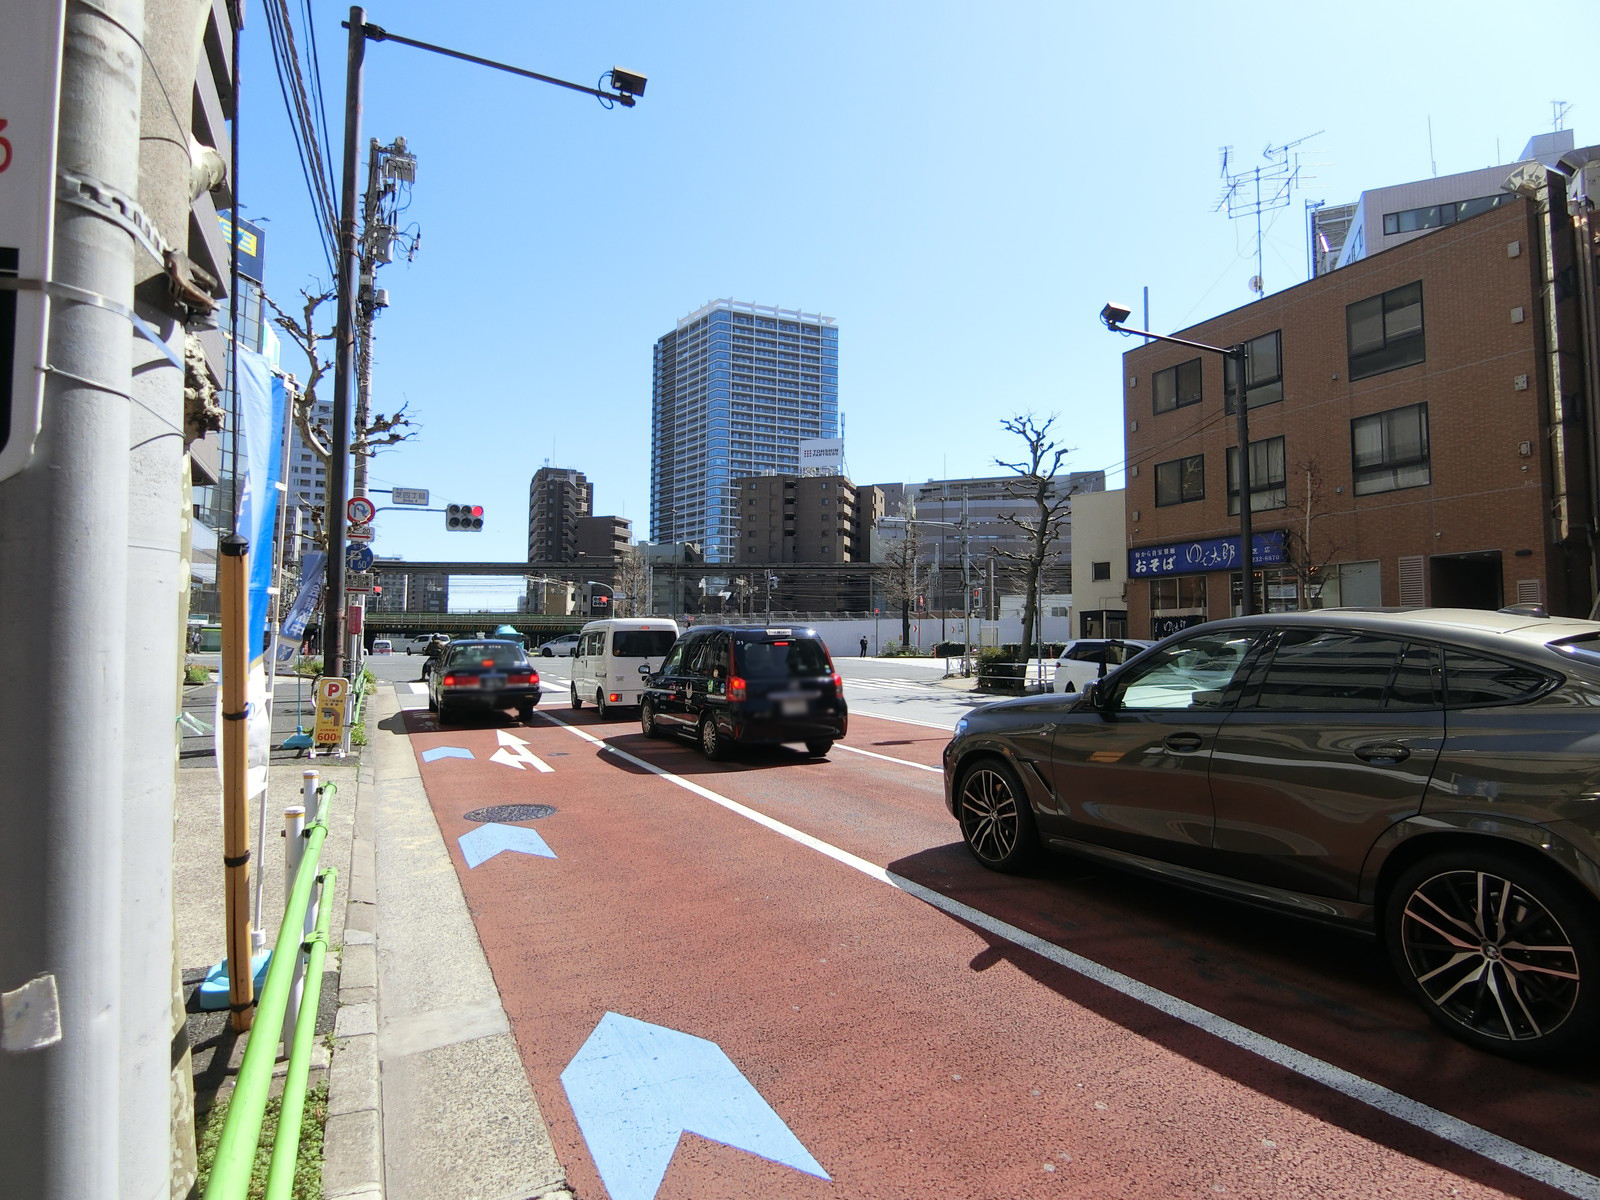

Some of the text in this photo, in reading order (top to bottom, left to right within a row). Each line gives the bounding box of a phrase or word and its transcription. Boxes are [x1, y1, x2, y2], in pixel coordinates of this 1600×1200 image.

[395, 490, 426, 500] 芝四丁目
[1186, 540, 1236, 568] ゆで太郎
[1135, 555, 1177, 574] おそば
[327, 683, 340, 697] P
